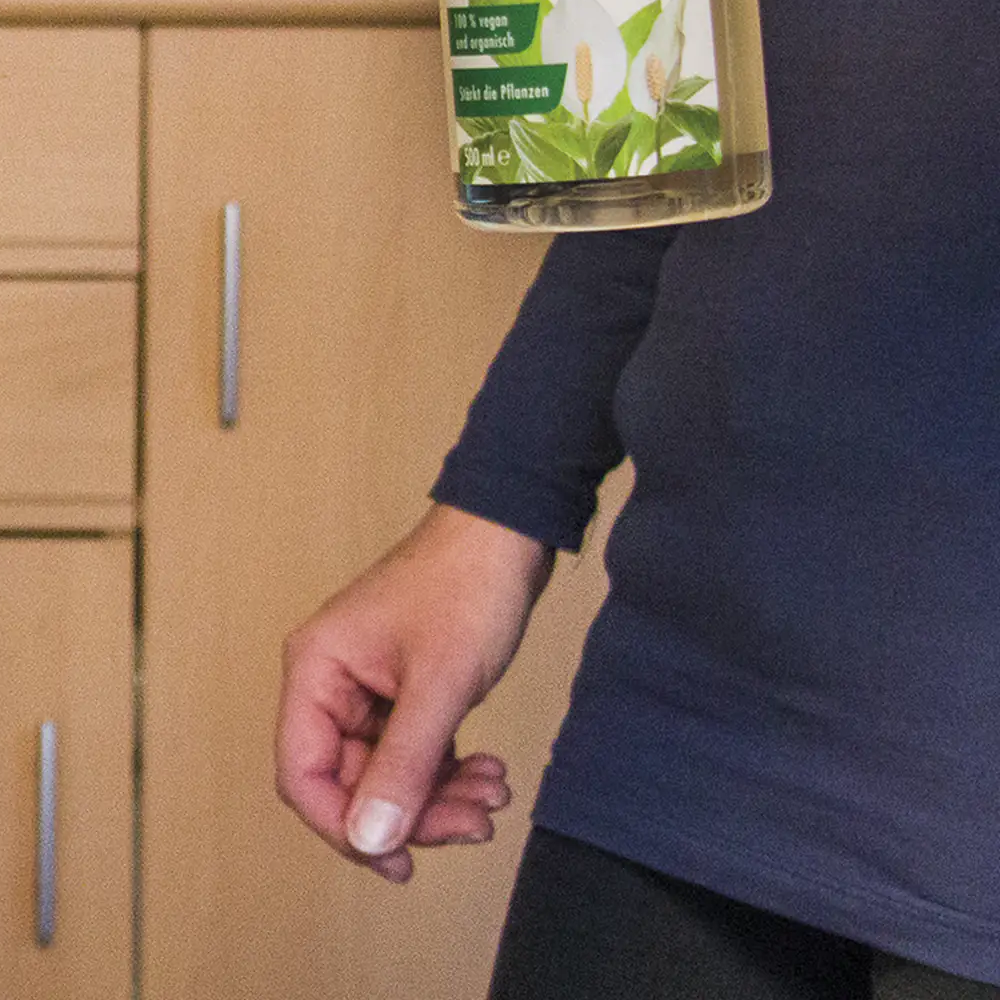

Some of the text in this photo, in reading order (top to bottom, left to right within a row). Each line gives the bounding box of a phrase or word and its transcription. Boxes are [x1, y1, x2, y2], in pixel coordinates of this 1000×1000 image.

[479, 15, 508, 31] vegan
[470, 31, 515, 53] organisch
[483, 84, 498, 101] die
[500, 83, 550, 101] Pflanzen
[464, 147, 480, 167] 500
[481, 144, 495, 167] ml
